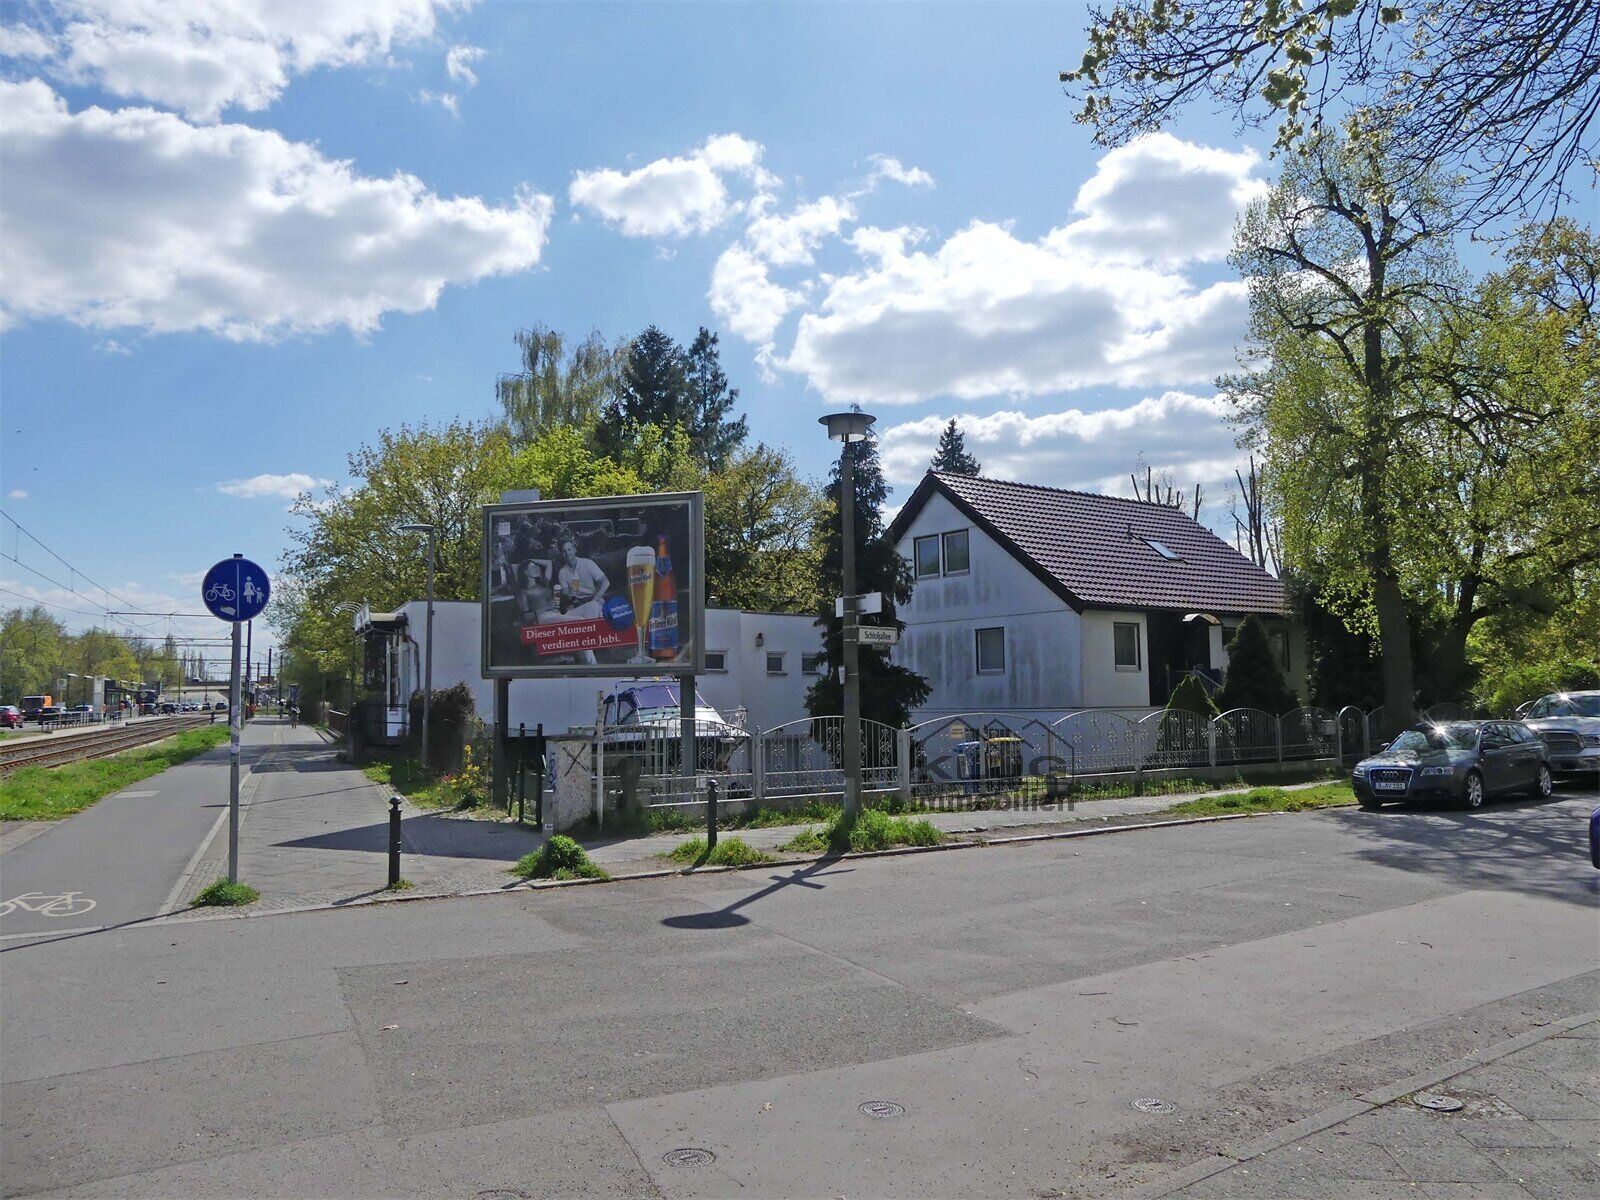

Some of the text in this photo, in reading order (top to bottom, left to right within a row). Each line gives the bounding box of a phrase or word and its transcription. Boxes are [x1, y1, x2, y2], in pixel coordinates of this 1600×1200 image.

[526, 624, 597, 640] Dieser Moment
[542, 633, 621, 651] verdient ein Jubi.
